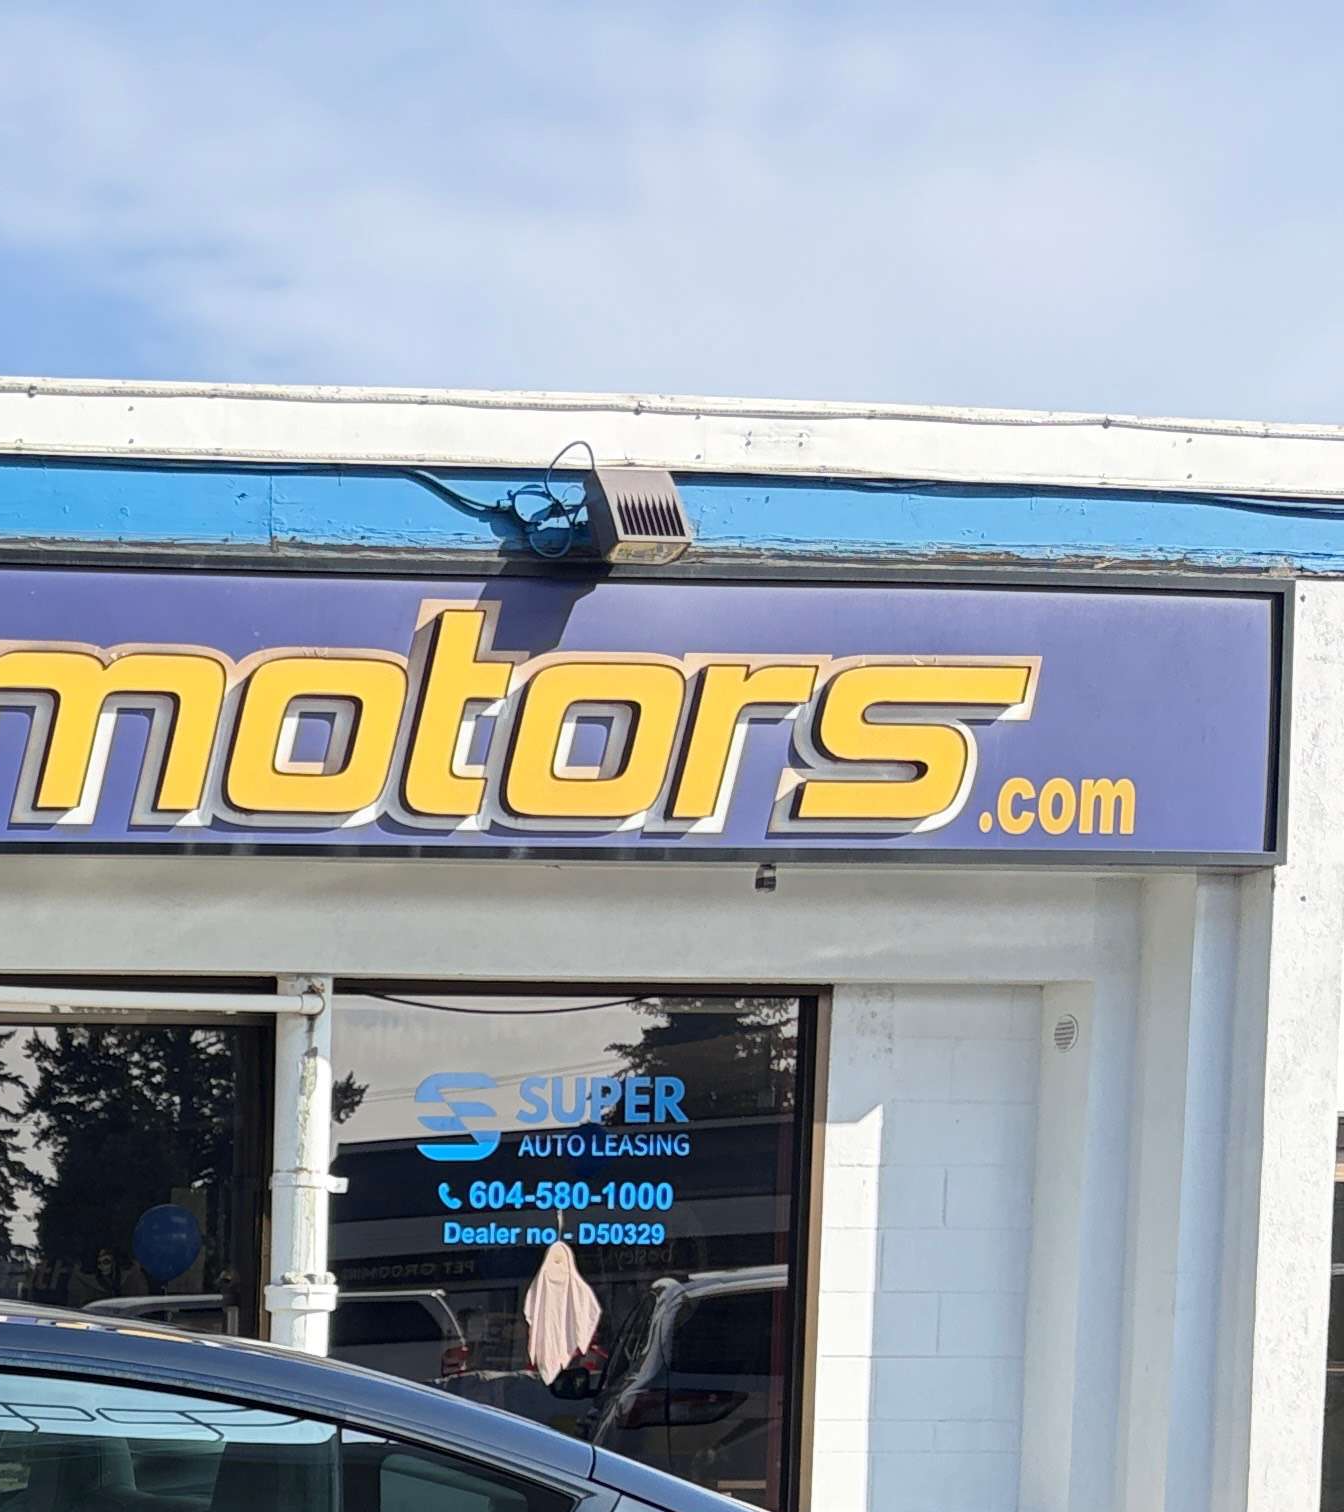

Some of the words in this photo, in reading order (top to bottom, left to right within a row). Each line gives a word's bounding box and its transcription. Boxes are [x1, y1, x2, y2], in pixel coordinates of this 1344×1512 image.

[979, 777, 1136, 835] .com
[516, 1076, 689, 1124] SUPER
[517, 1134, 586, 1158] AUTO
[591, 1134, 690, 1157] LEASING
[468, 1181, 674, 1211] 604-580-1000
[443, 1222, 521, 1245] Dealer
[526, 1227, 556, 1245] no
[579, 1223, 665, 1246] D50329
